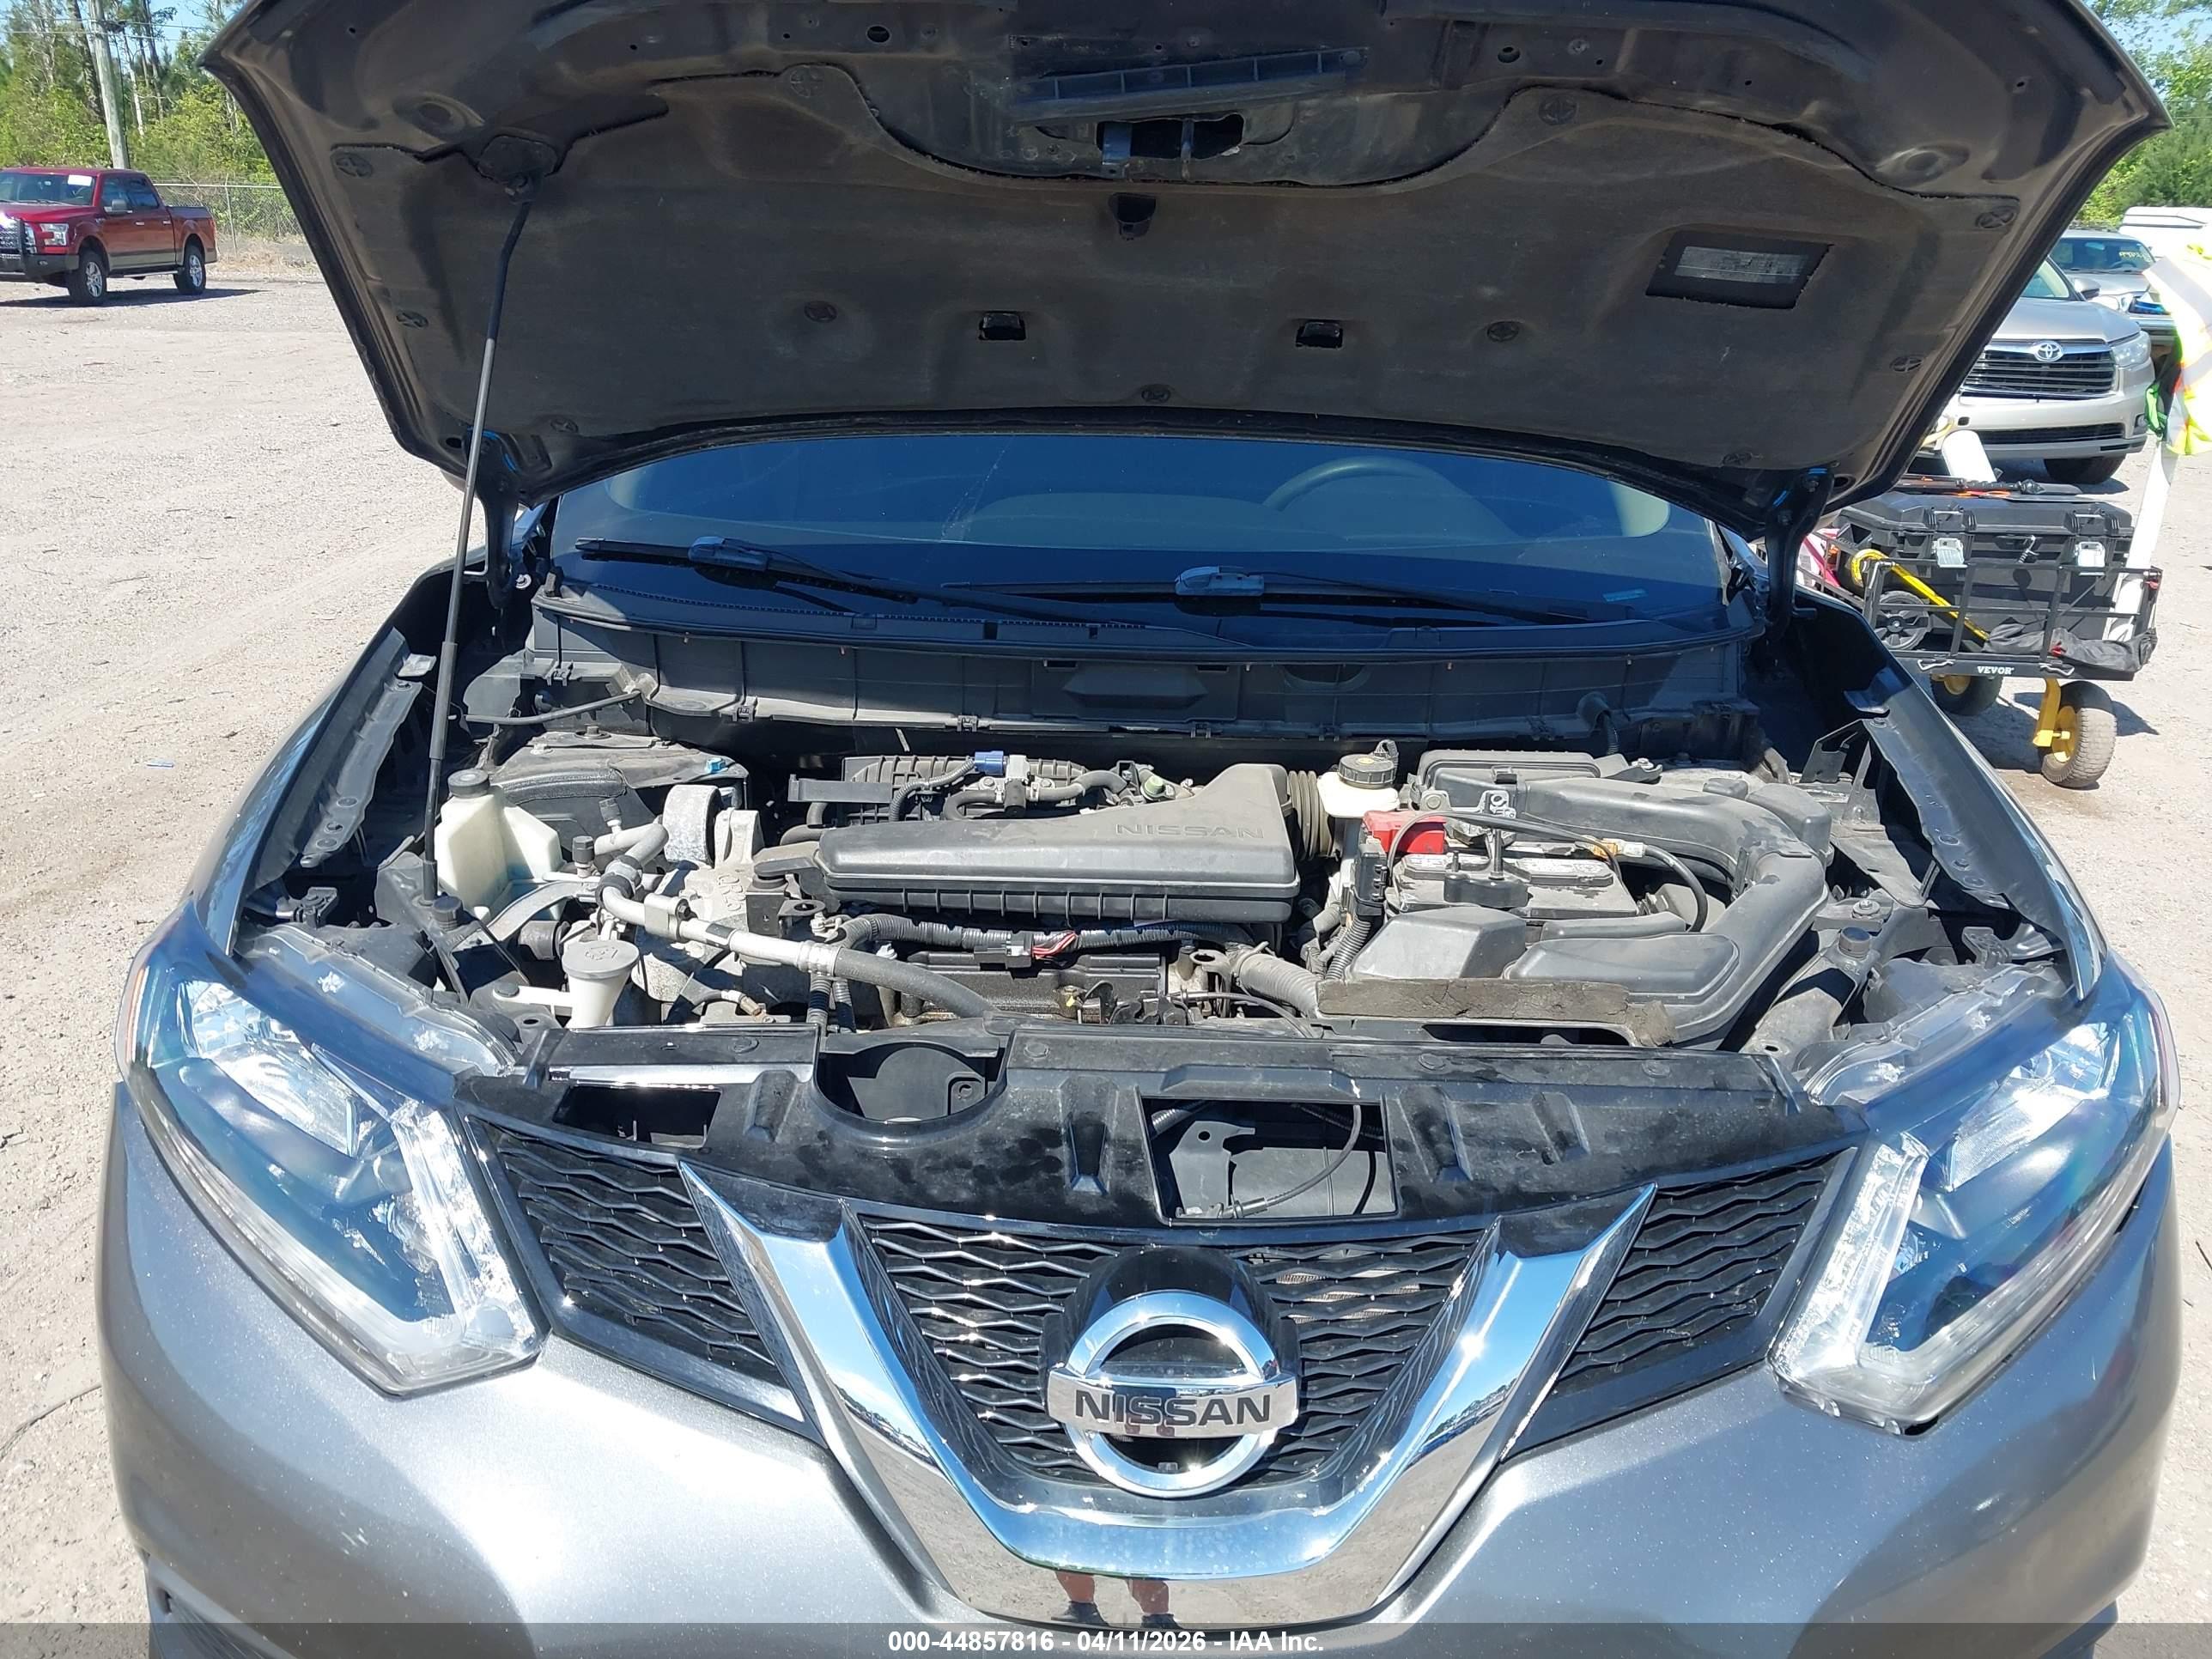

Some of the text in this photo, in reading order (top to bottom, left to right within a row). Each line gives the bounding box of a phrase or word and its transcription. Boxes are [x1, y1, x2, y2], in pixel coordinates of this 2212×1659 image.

[1978, 665, 2012, 675] VEVOR
[1115, 823, 1264, 840] NISSAN
[1075, 1389, 1271, 1425] NISSAN
